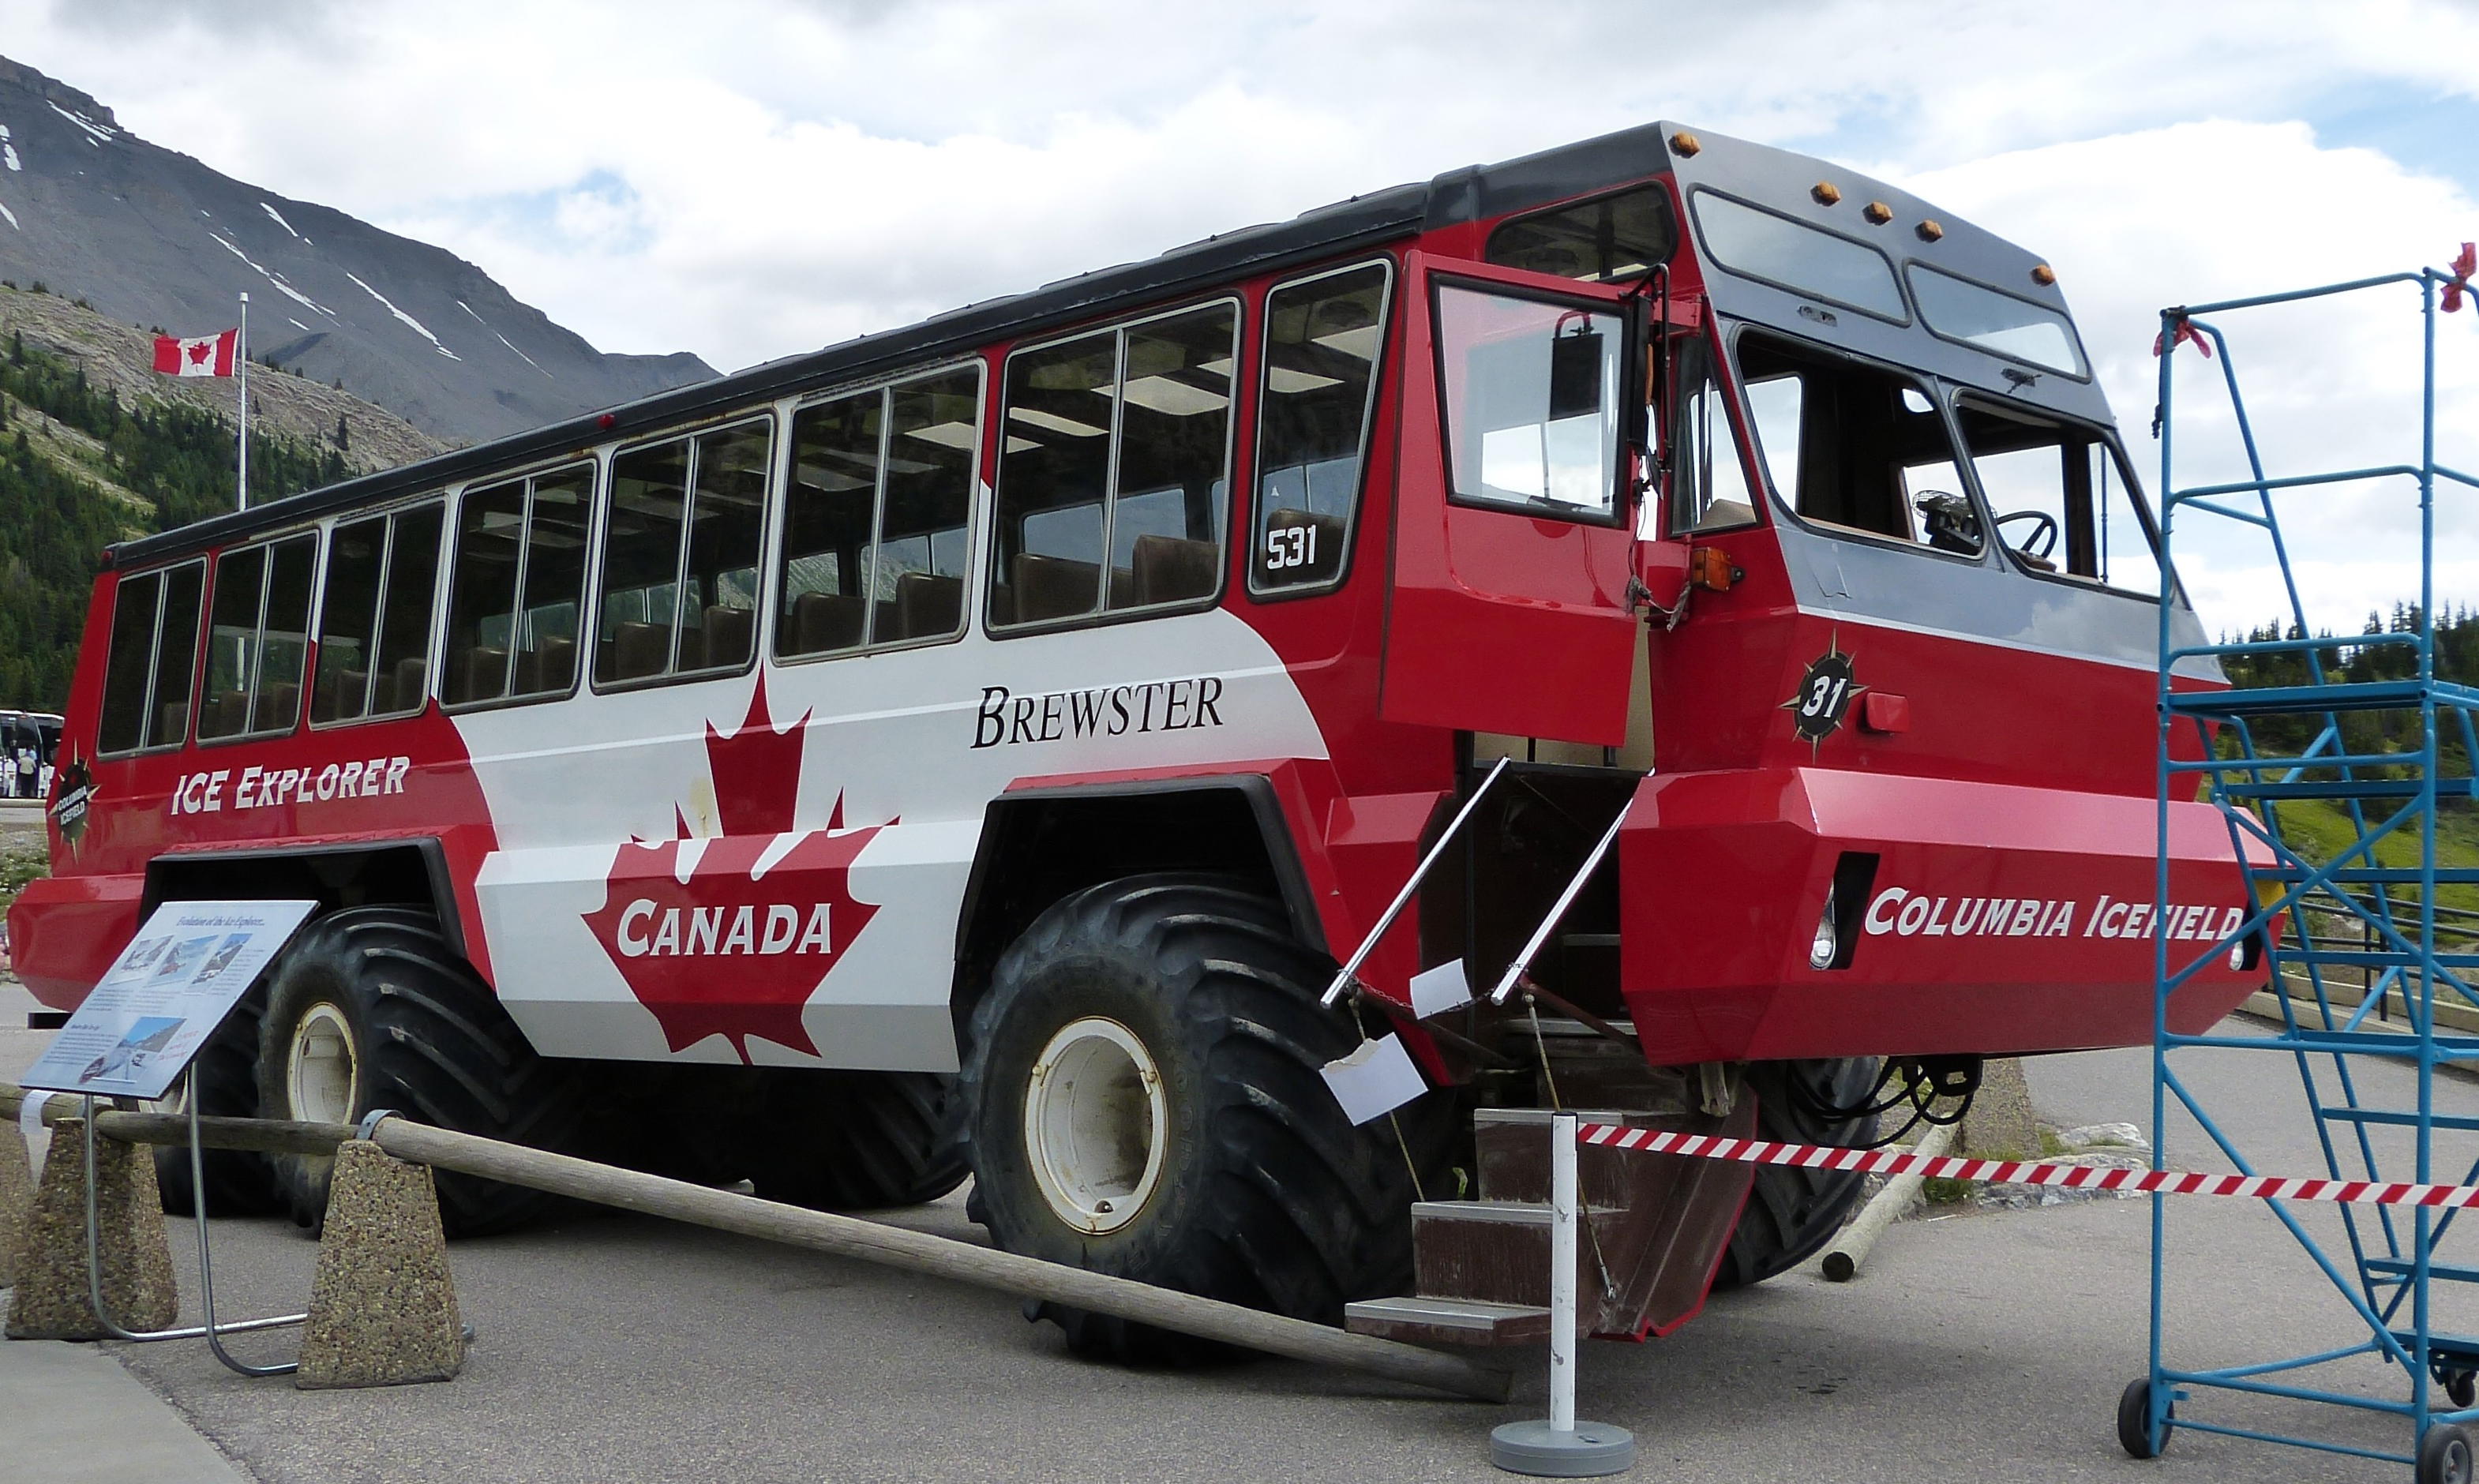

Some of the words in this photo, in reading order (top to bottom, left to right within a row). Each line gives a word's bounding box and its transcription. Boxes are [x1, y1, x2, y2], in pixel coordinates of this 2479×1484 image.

[1267, 524, 1317, 569] 531
[970, 676, 1223, 748] BREWSTER
[1802, 675, 1847, 718] 31
[171, 768, 231, 815] ICE
[234, 755, 411, 810] EXPLORER
[617, 898, 832, 957] CANADA
[1865, 886, 2076, 937] COLUMBIA
[2083, 894, 2244, 941] ICEFIELD
